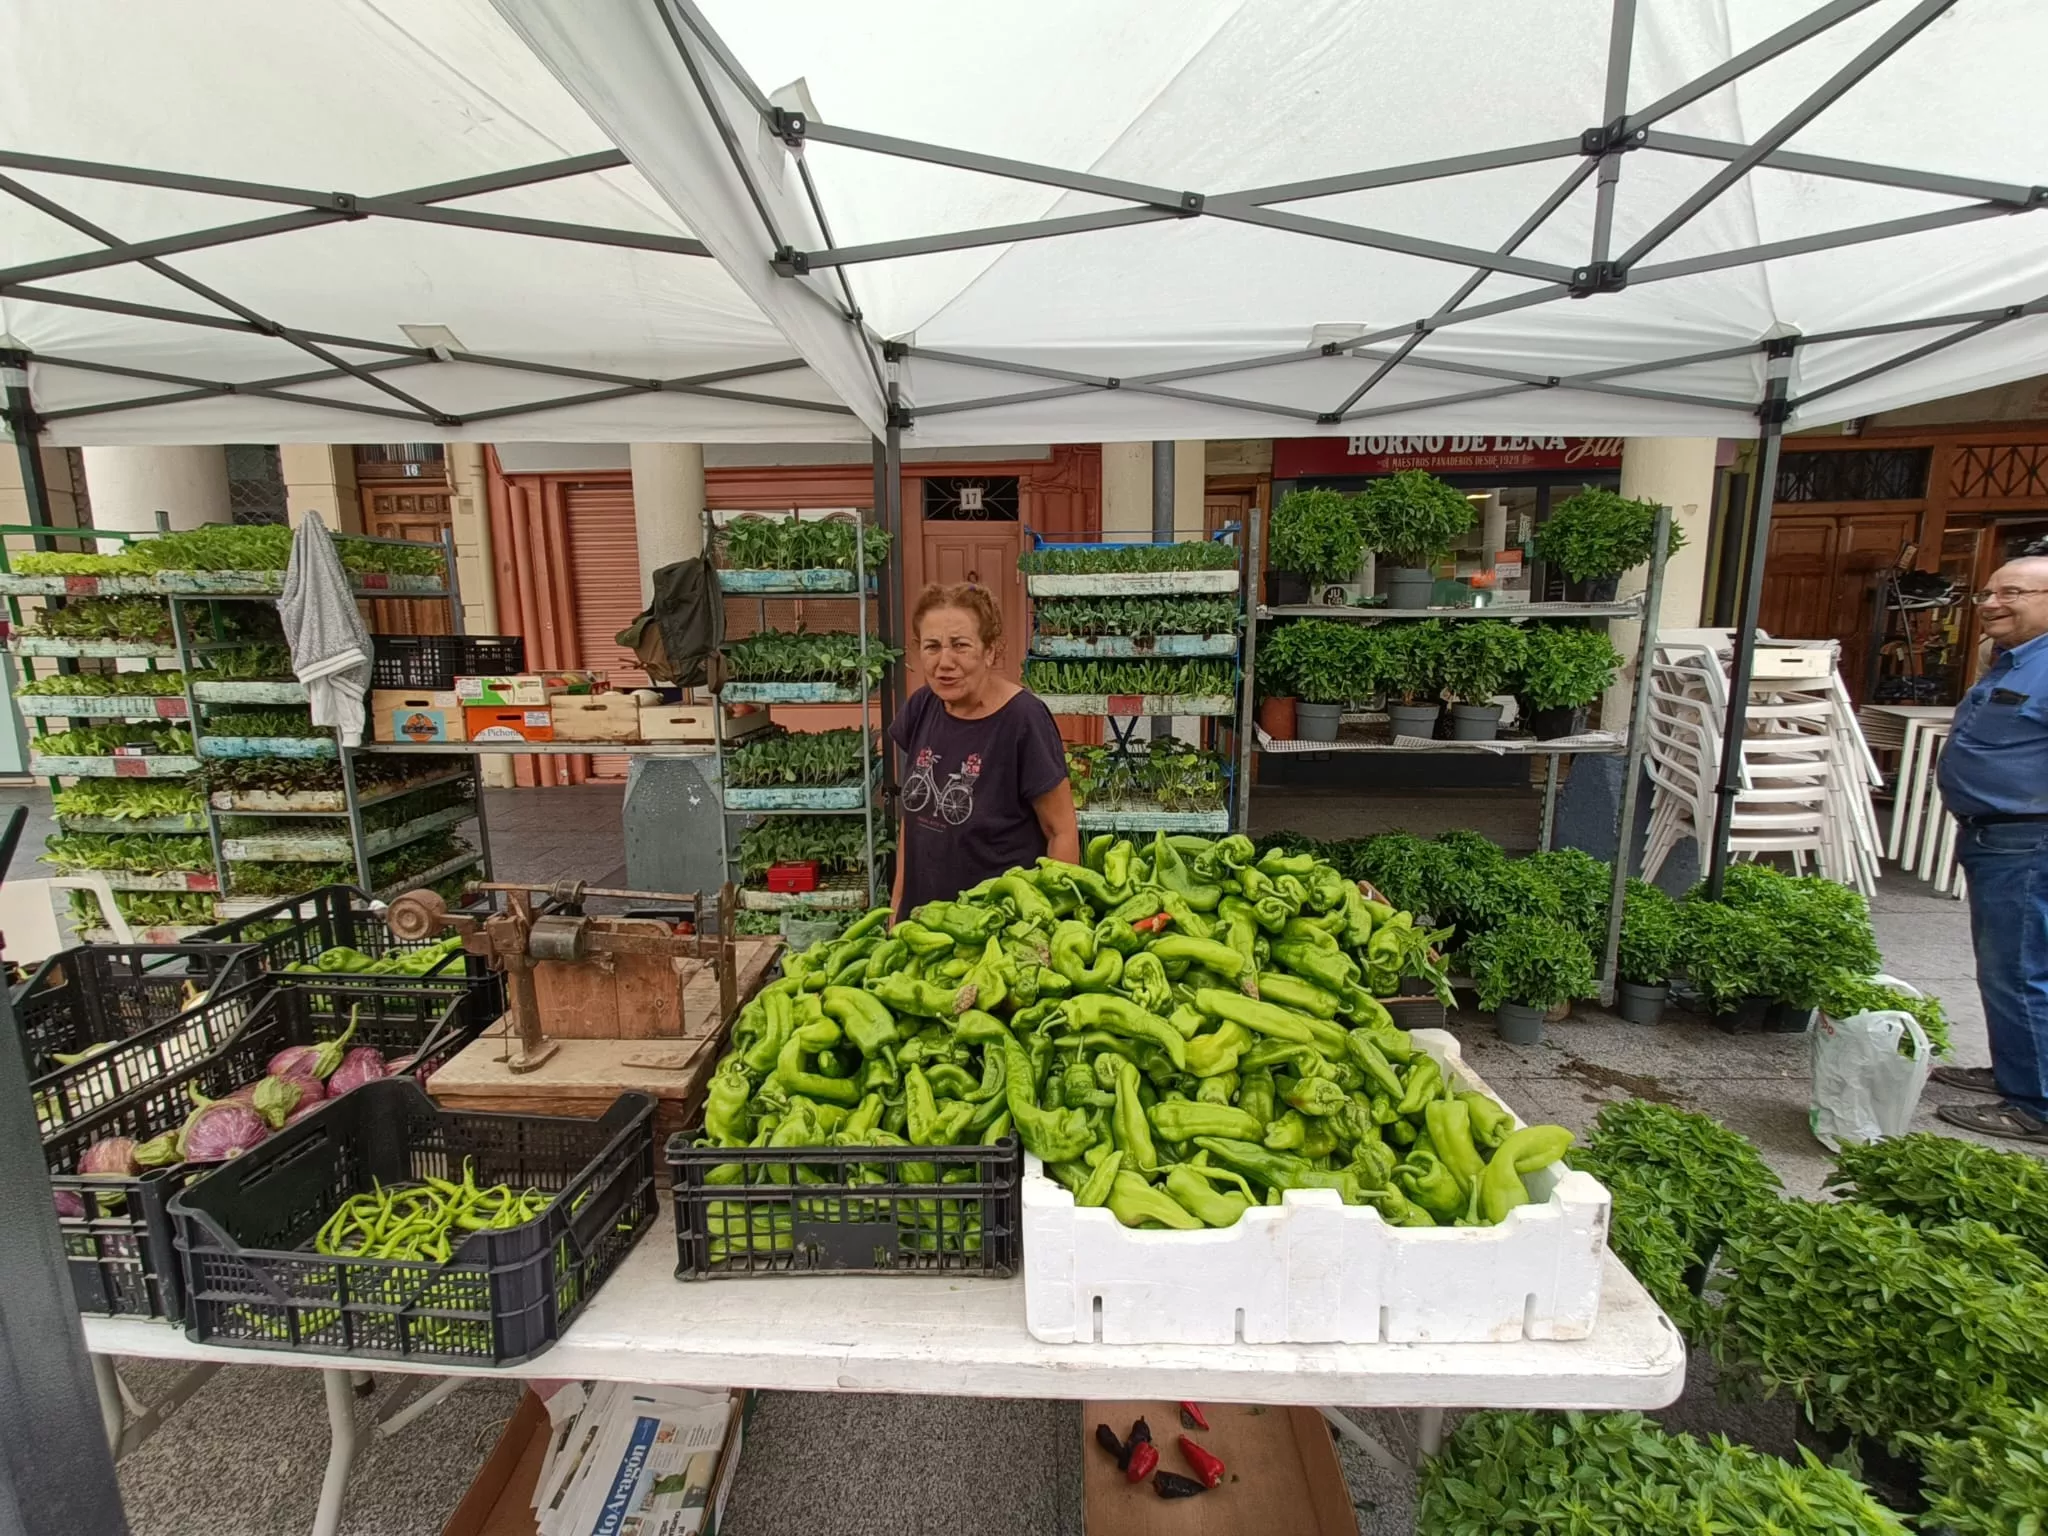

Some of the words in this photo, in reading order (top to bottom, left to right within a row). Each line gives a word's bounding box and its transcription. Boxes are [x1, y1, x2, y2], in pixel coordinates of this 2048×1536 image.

[1347, 436, 1445, 455] HORNO
[1450, 436, 1487, 453] DE
[1392, 457, 1429, 468] MAESTROS
[1432, 456, 1473, 467] PANADEROS
[1475, 455, 1497, 466] DESDE
[966, 493, 977, 504] 17
